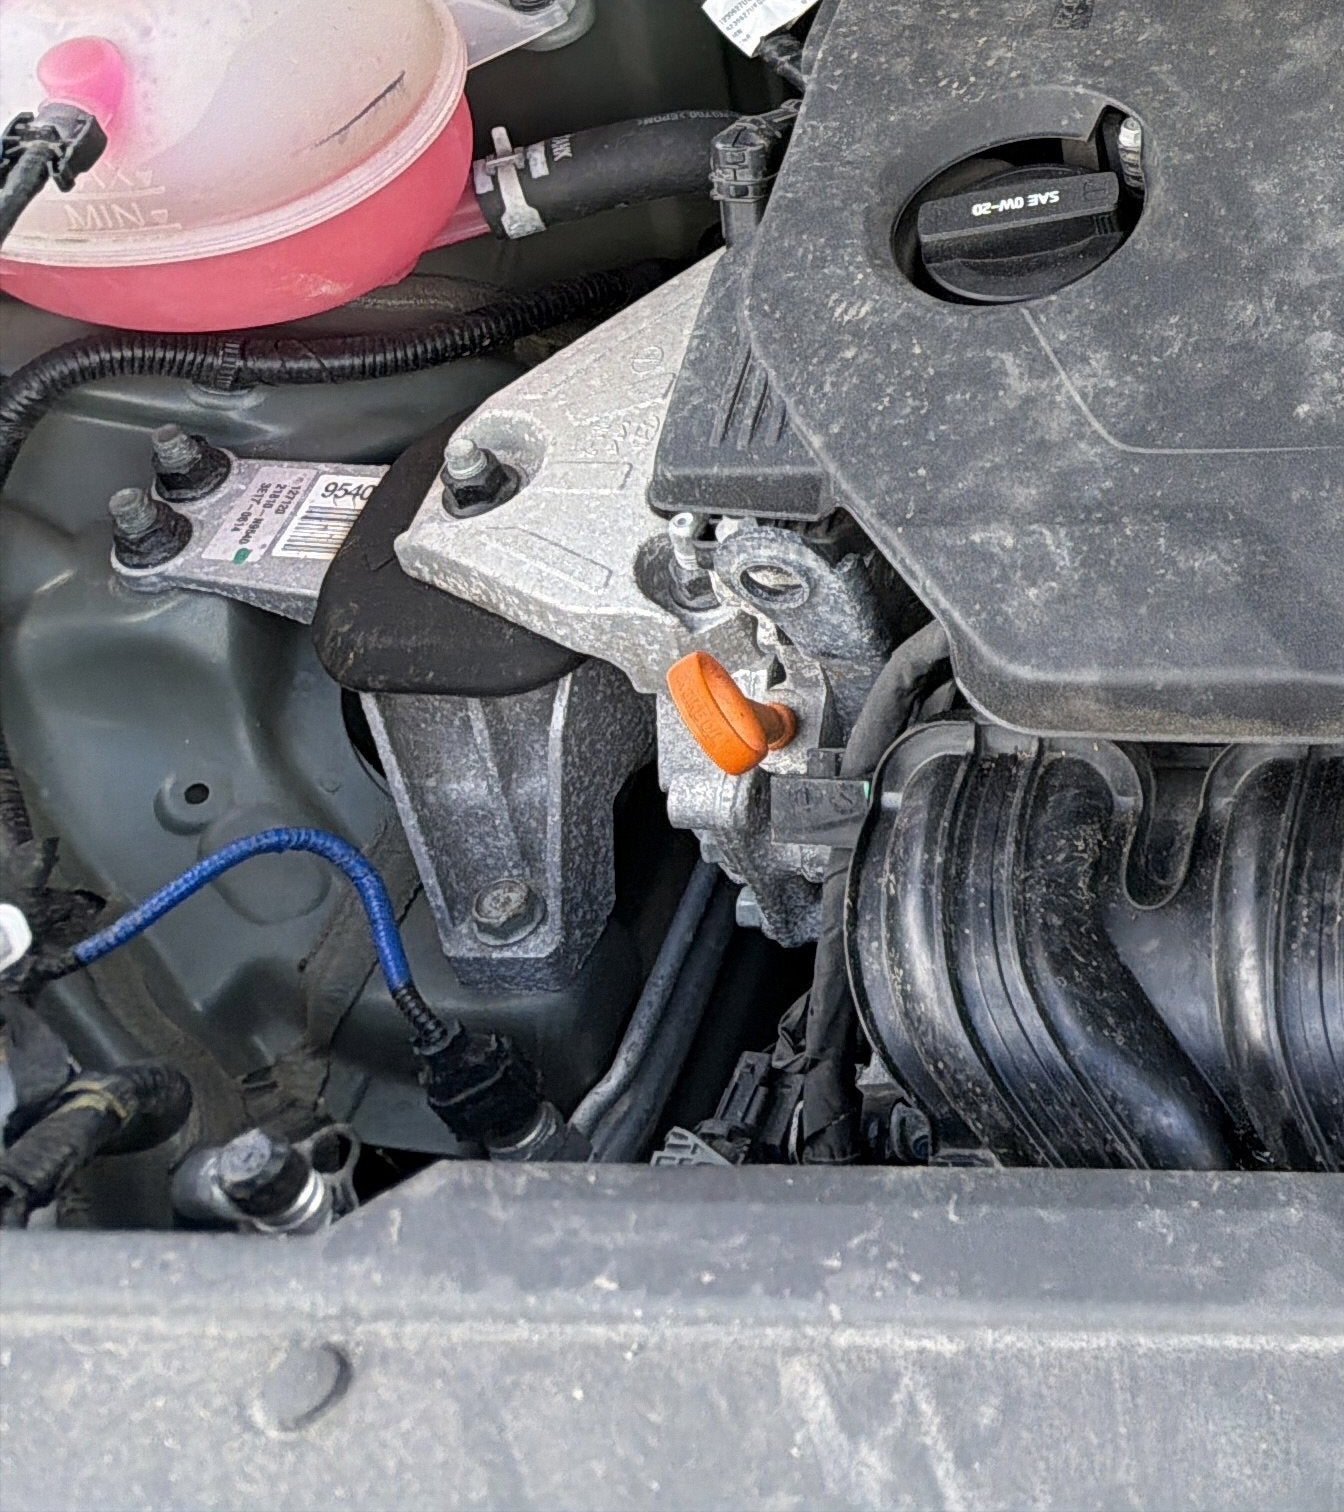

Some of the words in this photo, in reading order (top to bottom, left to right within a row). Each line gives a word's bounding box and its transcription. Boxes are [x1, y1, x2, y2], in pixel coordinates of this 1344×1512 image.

[971, 196, 1025, 216] 0W-20
[1027, 190, 1060, 207] SAE
[63, 202, 146, 229] MIN
